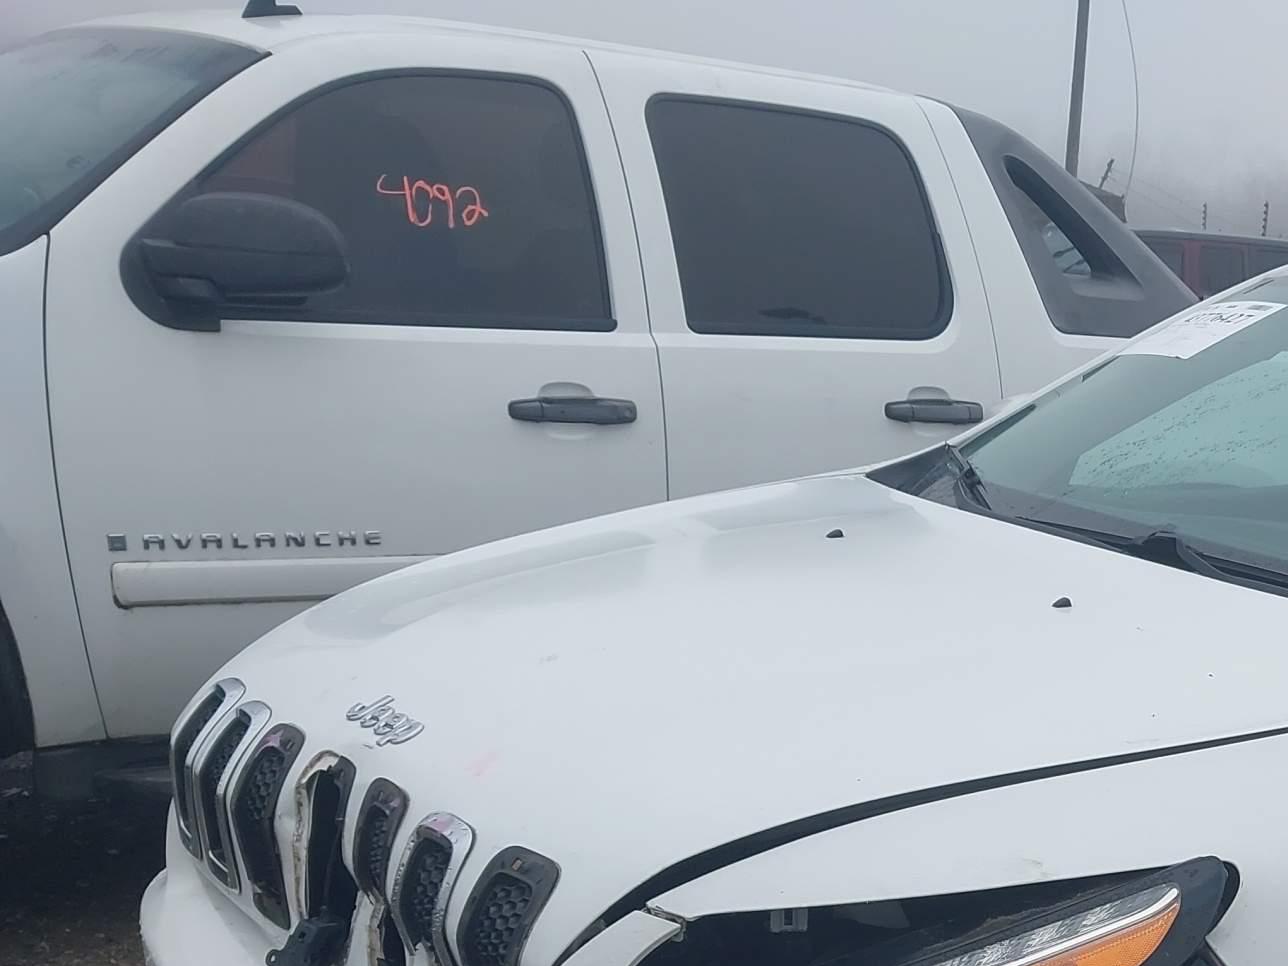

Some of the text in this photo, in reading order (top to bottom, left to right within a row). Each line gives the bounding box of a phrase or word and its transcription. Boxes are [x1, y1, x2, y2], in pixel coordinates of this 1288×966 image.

[376, 174, 489, 228] 4092
[142, 530, 383, 551] AVALANCHE
[345, 694, 425, 747] Jeep
